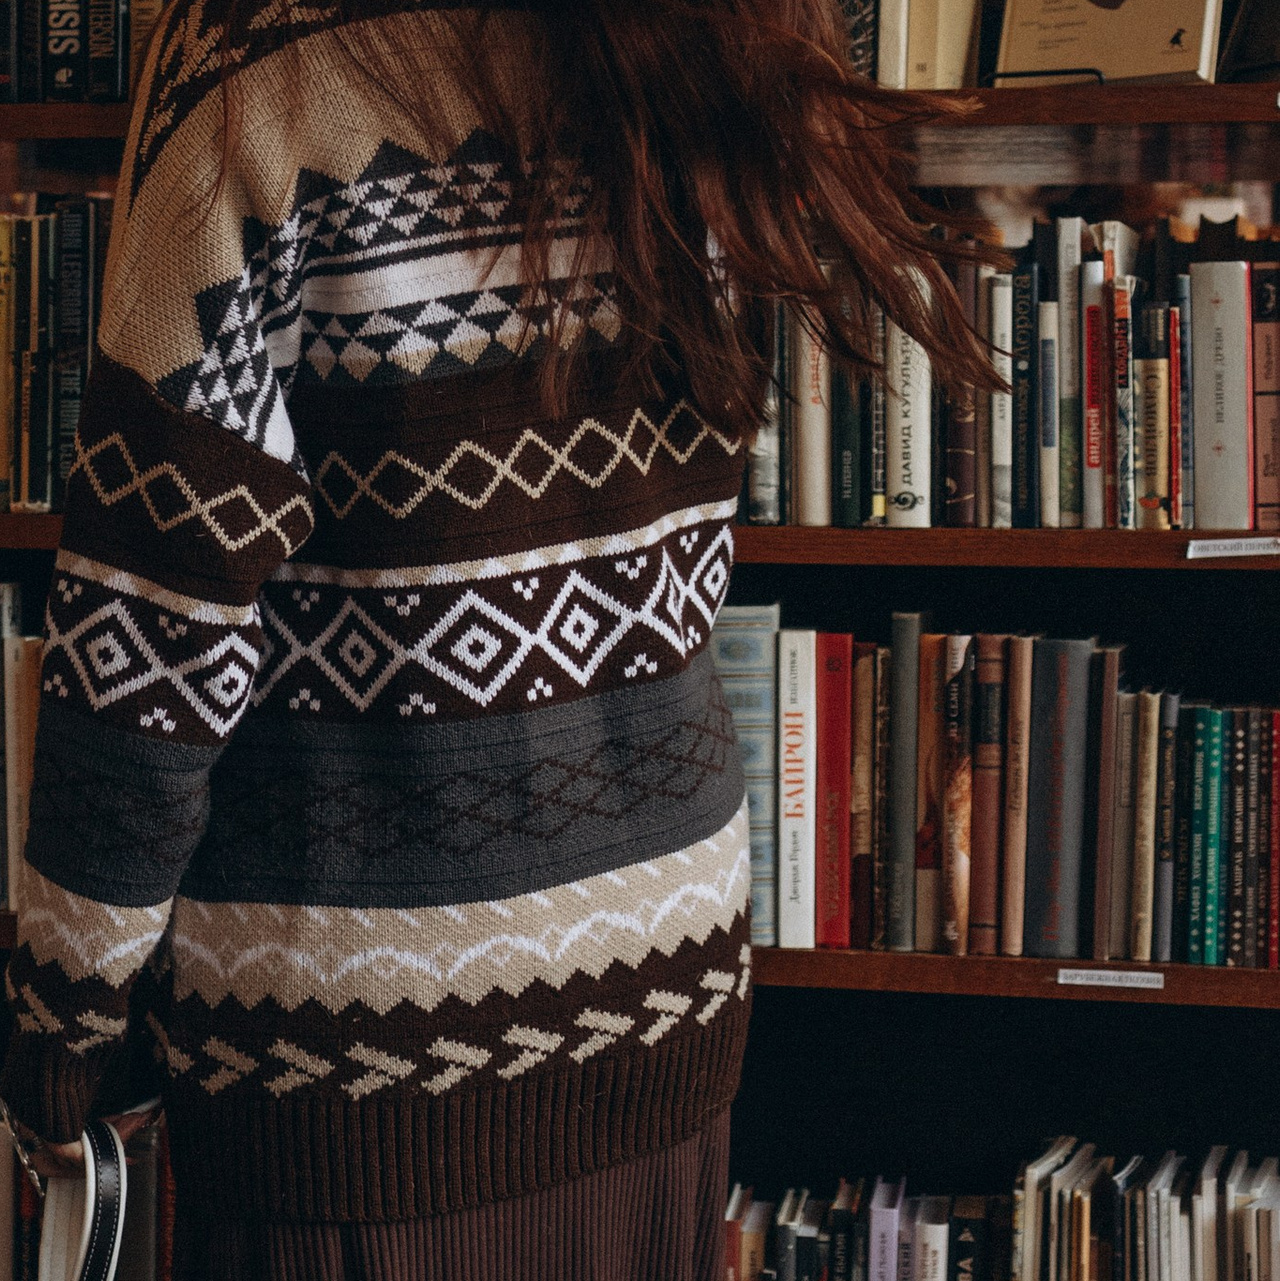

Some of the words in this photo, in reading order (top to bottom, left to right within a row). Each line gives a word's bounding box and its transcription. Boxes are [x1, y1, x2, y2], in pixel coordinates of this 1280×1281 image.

[60, 210, 81, 248] JOHN
[60, 253, 81, 335] LESCROART
[1213, 326, 1225, 366] ДРЕВО
[59, 367, 81, 394] THE
[1214, 369, 1225, 424] ВЕЛИКОЕ
[59, 398, 81, 438] HUNT
[1087, 407, 1101, 465] андрей
[900, 425, 914, 487] ДАВИД
[949, 683, 960, 718] СЕМИ
[781, 709, 806, 820] БАЙРОН
[1234, 785, 1245, 843] ИЗБРАННОЕ
